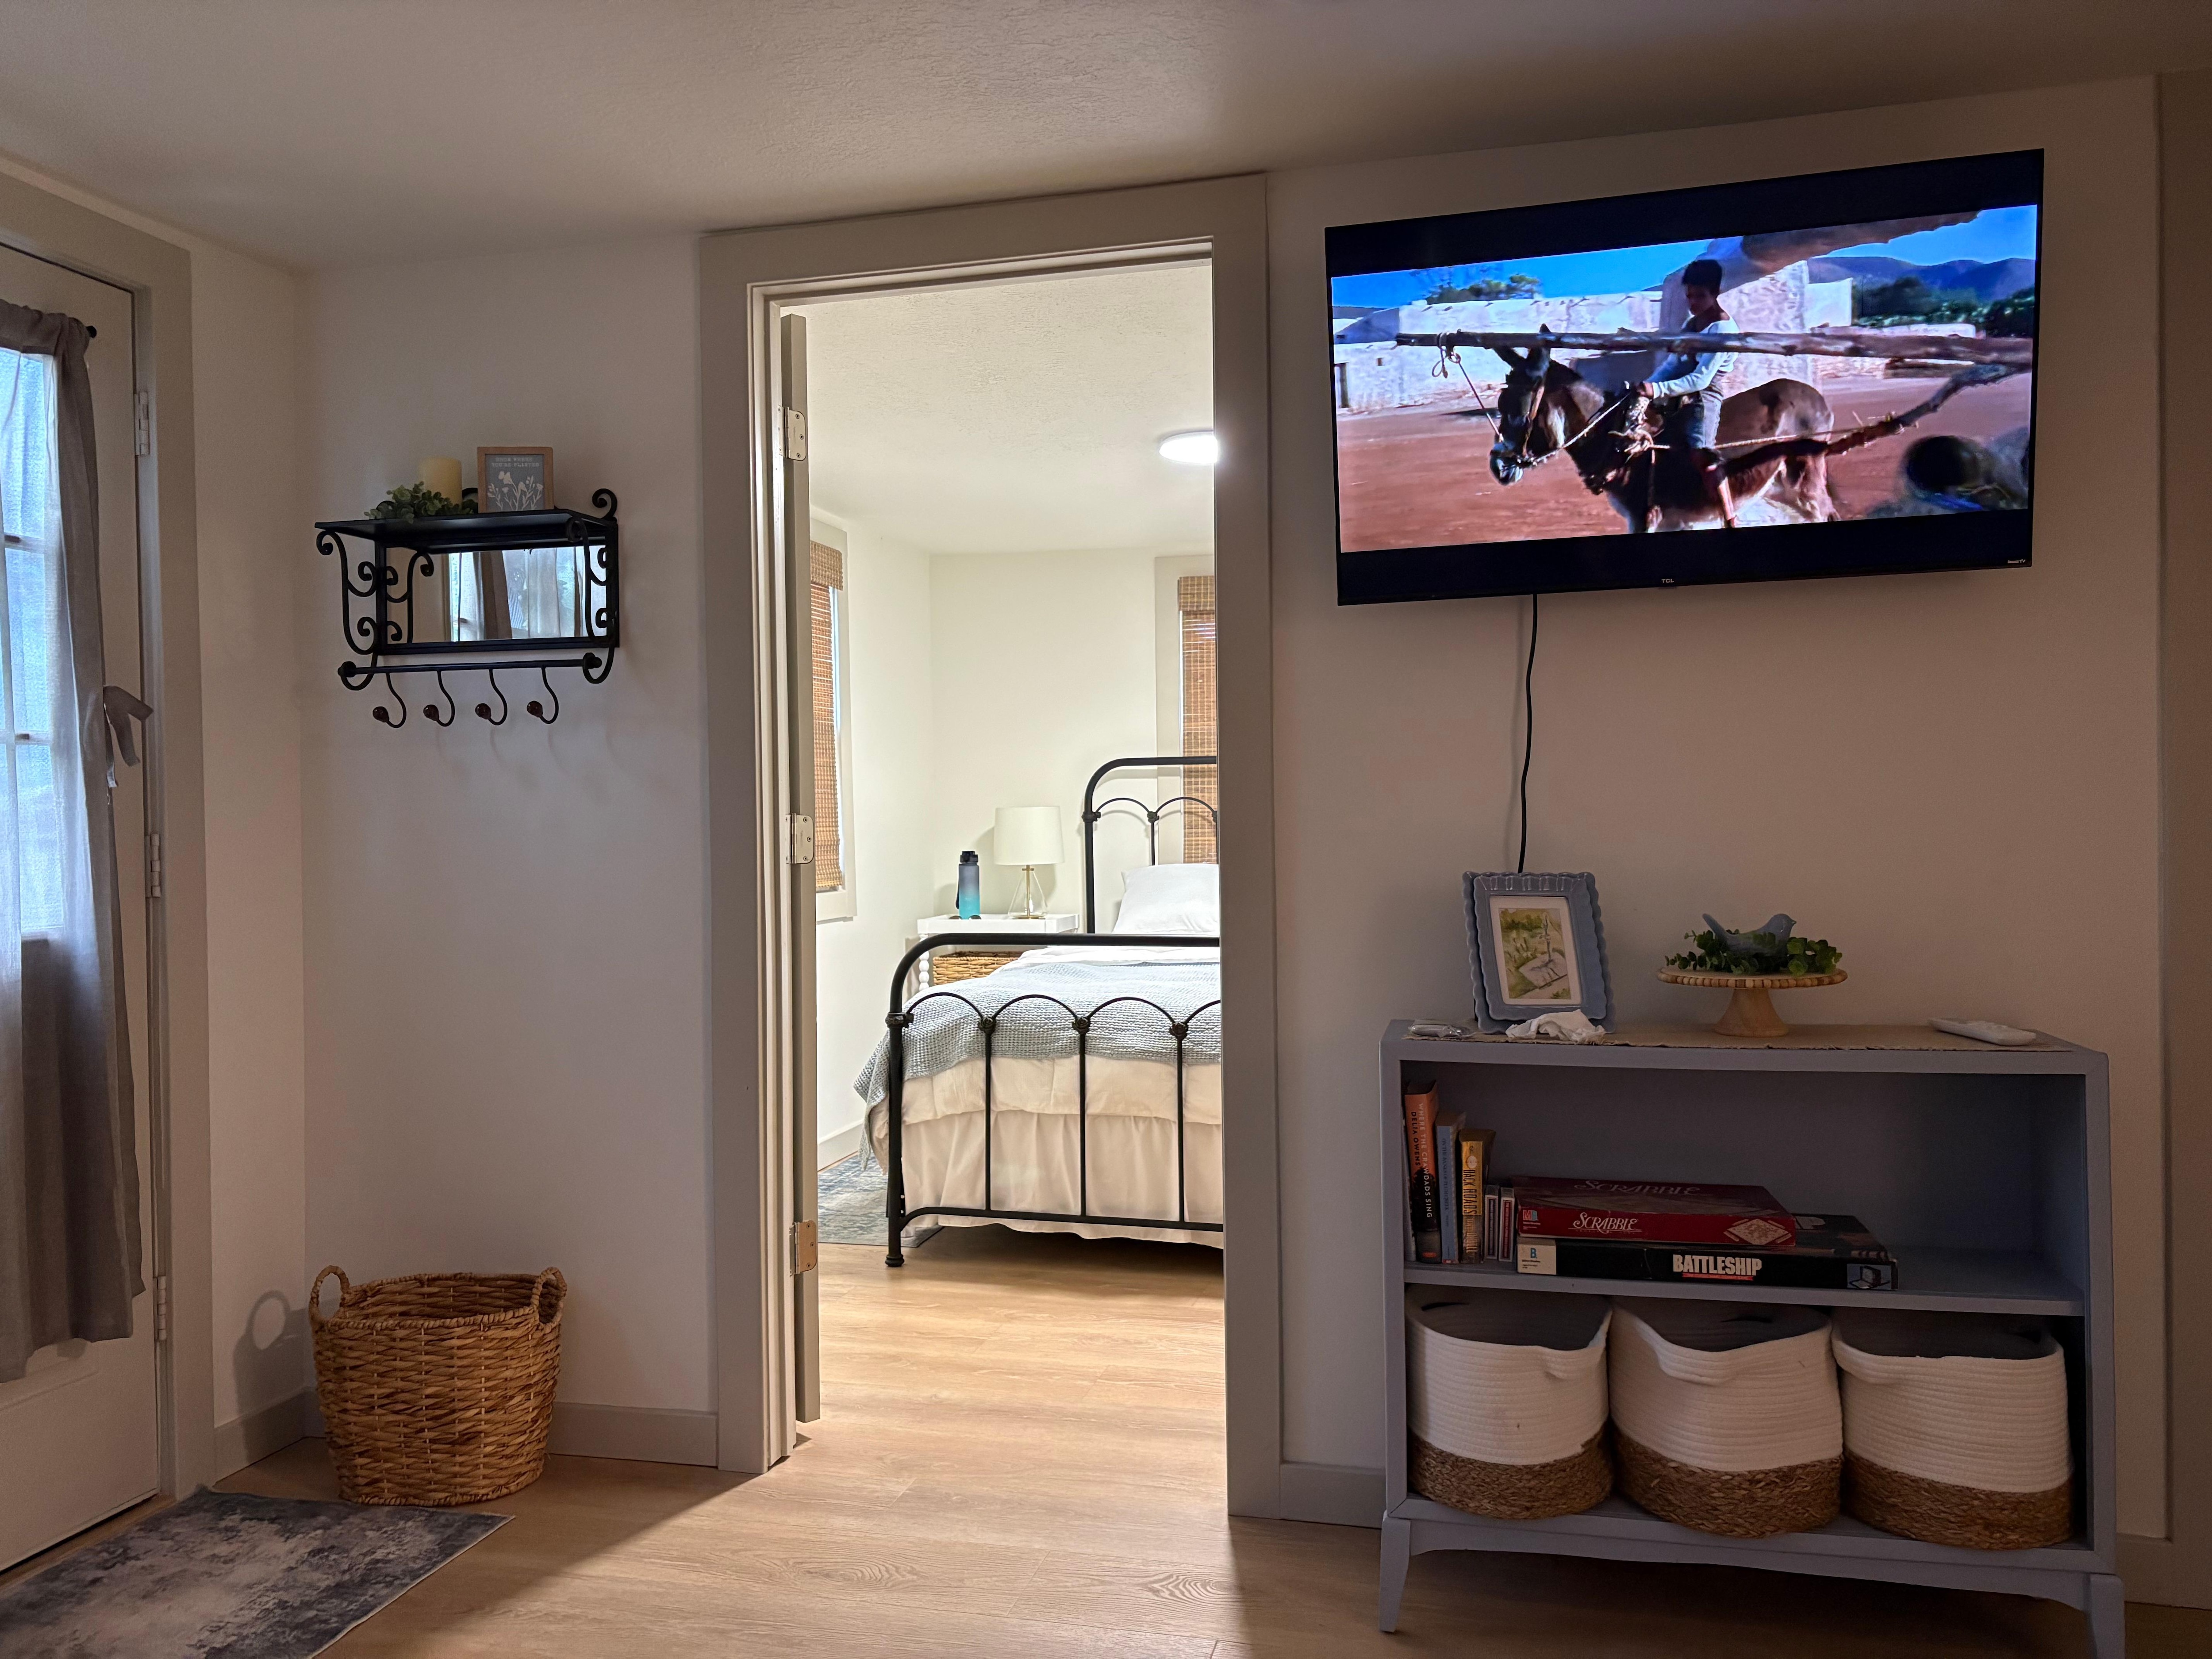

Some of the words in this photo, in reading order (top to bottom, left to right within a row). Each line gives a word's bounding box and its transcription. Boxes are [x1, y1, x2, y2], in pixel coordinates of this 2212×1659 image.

[1421, 1152, 1432, 1196] CRAWDADS
[1574, 1180, 1700, 1195] SCRABBLE
[1463, 1189, 1477, 1214] ROADS
[1573, 1212, 1638, 1234] SCRABBLE
[1672, 1254, 1762, 1276] BATTLESHIP
